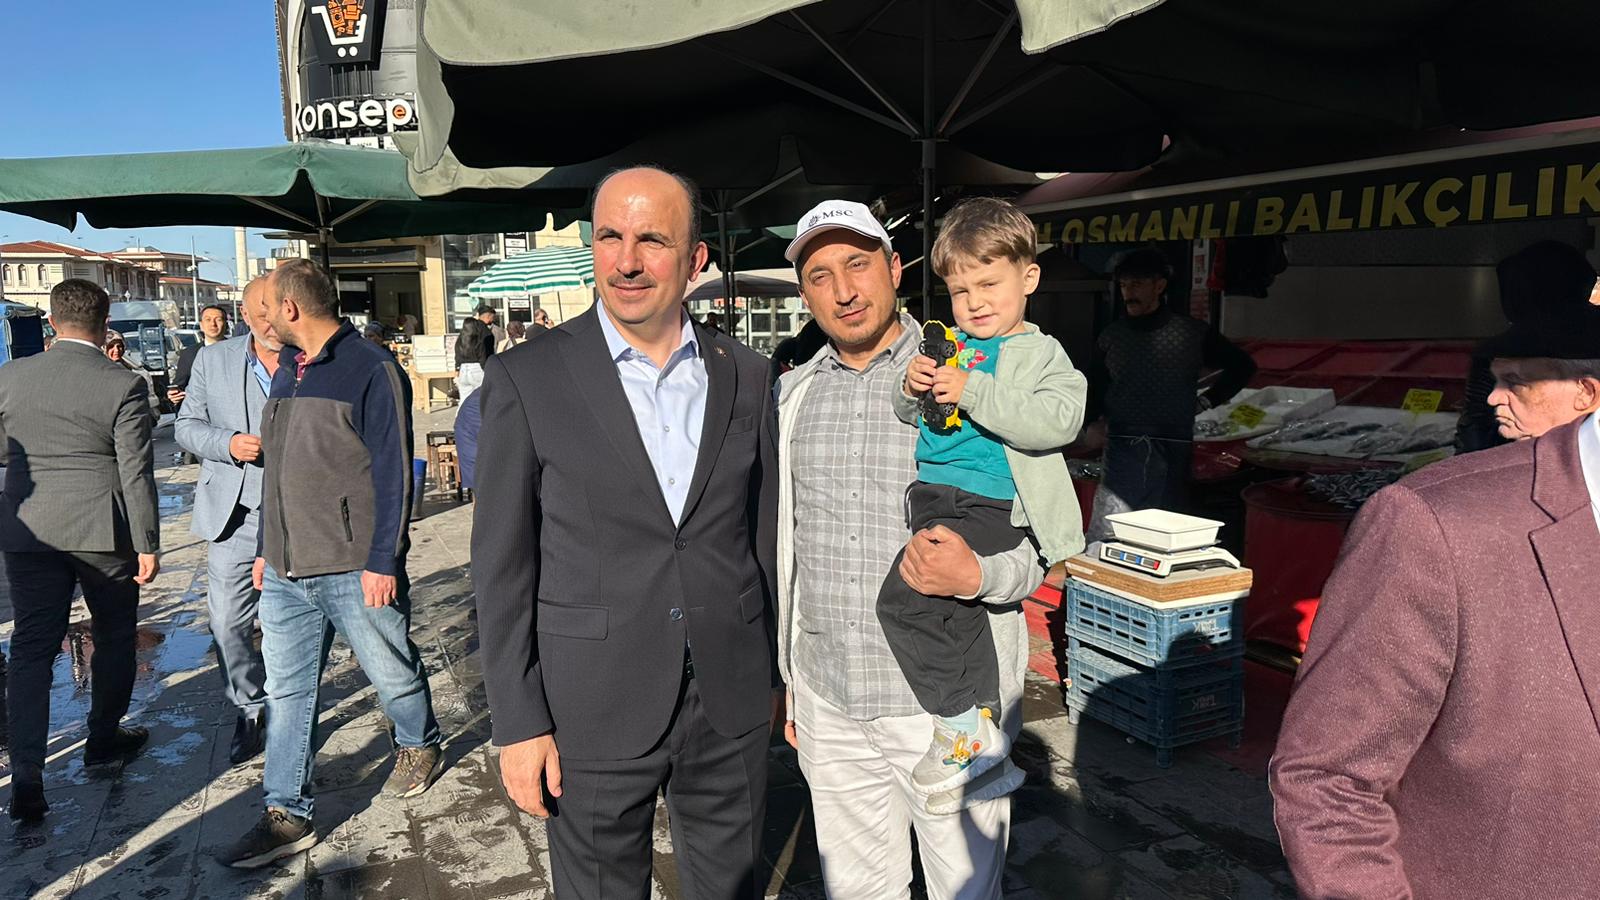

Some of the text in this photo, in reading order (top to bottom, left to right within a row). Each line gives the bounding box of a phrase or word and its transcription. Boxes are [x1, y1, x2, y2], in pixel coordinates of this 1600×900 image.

[822, 209, 854, 220] MSC
[1060, 199, 1241, 244] OSMANLI
[1252, 161, 1600, 237] BALIKÇILIK
